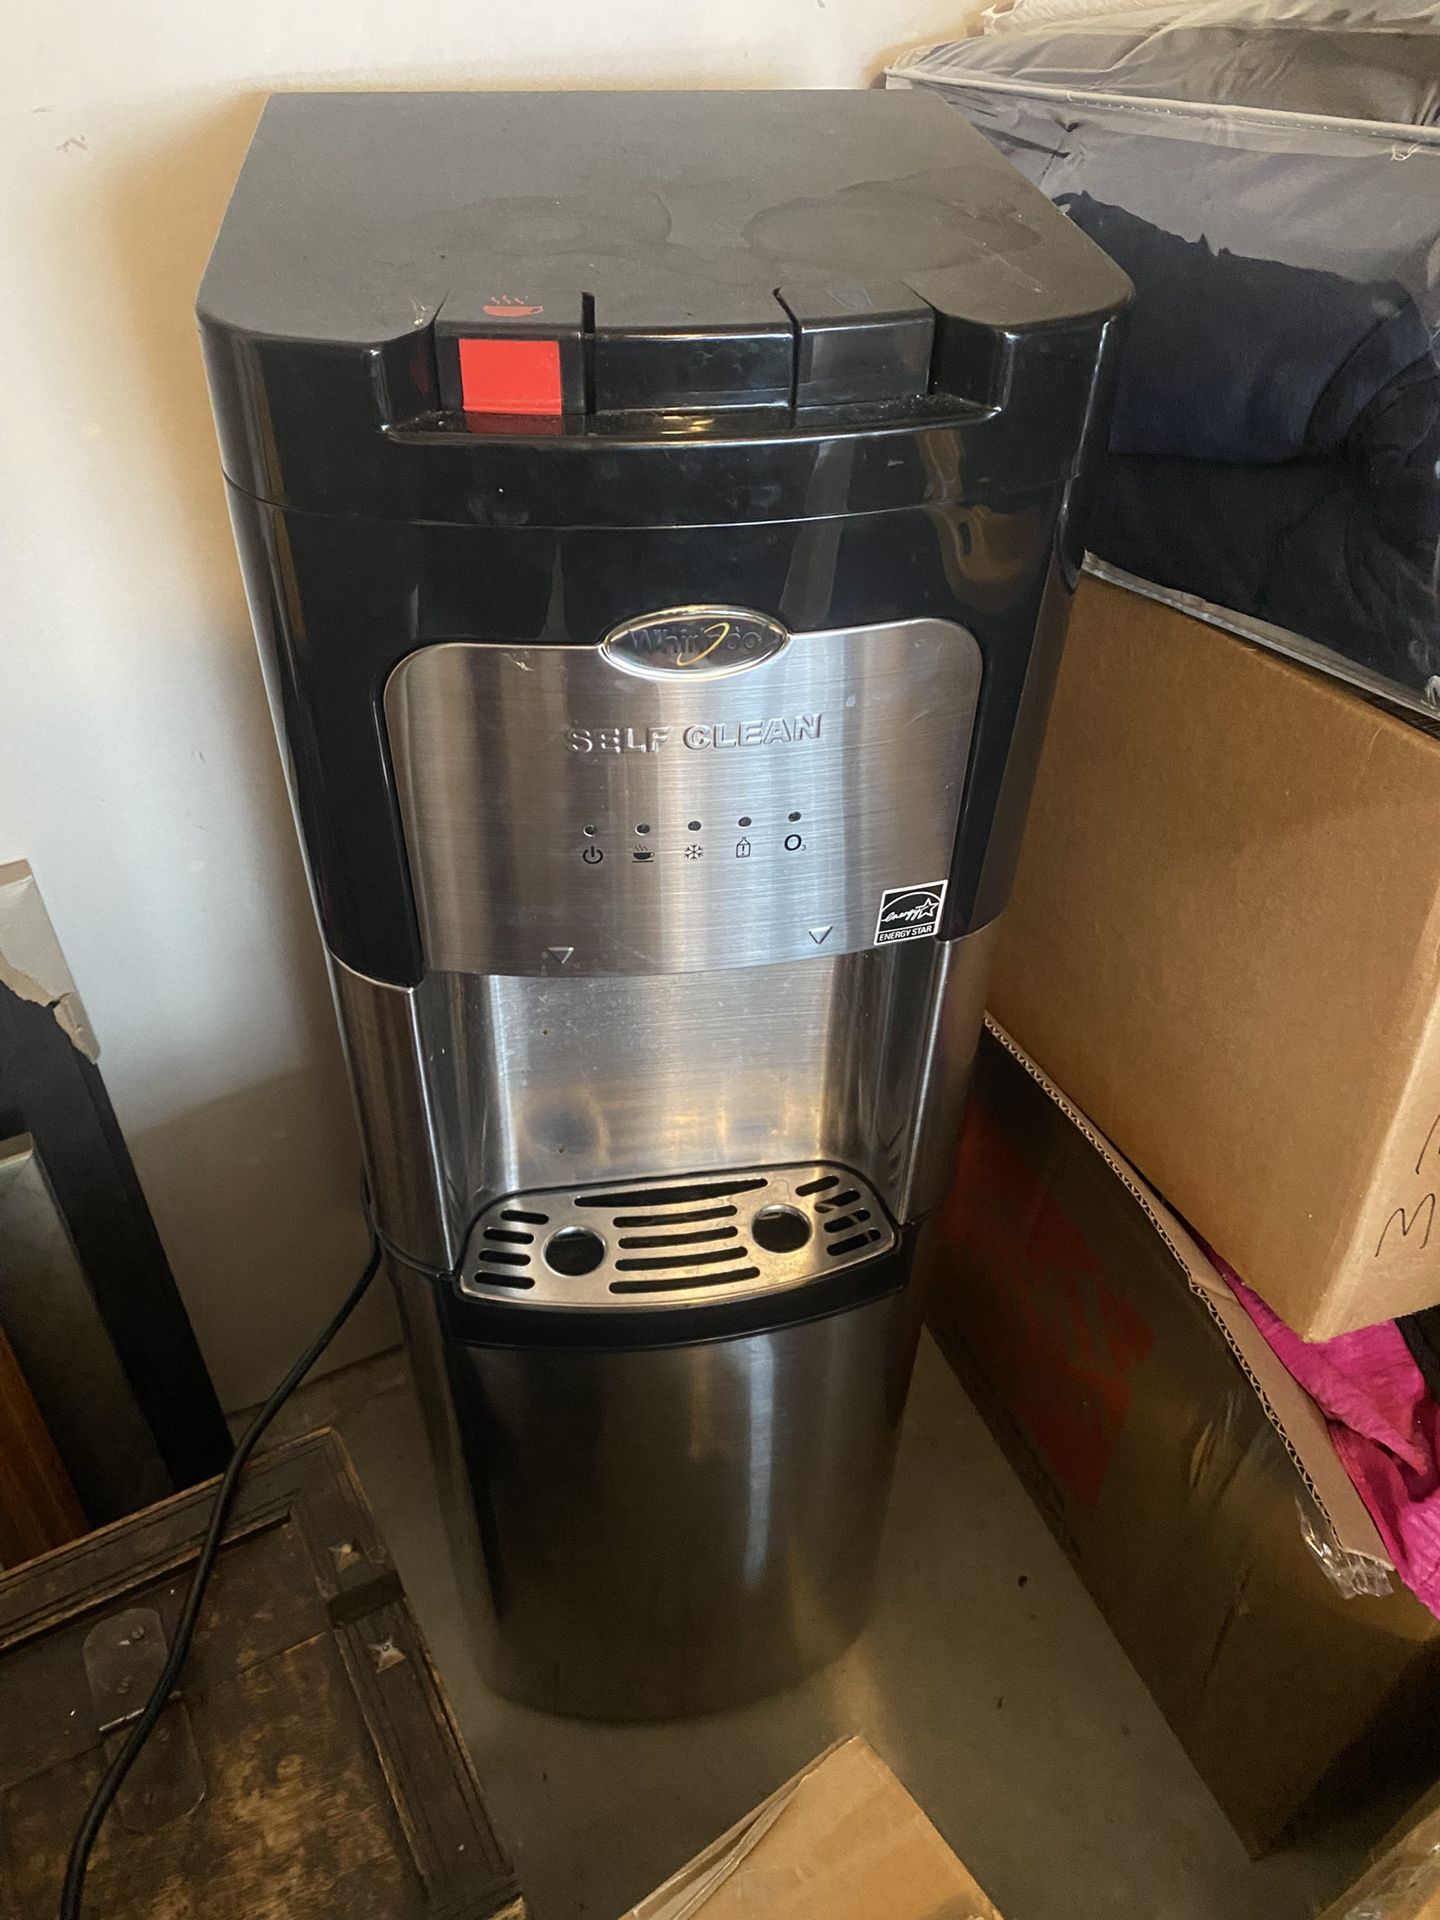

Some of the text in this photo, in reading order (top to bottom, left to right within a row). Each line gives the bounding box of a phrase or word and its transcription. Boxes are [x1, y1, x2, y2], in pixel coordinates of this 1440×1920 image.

[566, 713, 822, 753] SELF CLEAN
[879, 925, 932, 941] ENERGY STAR
